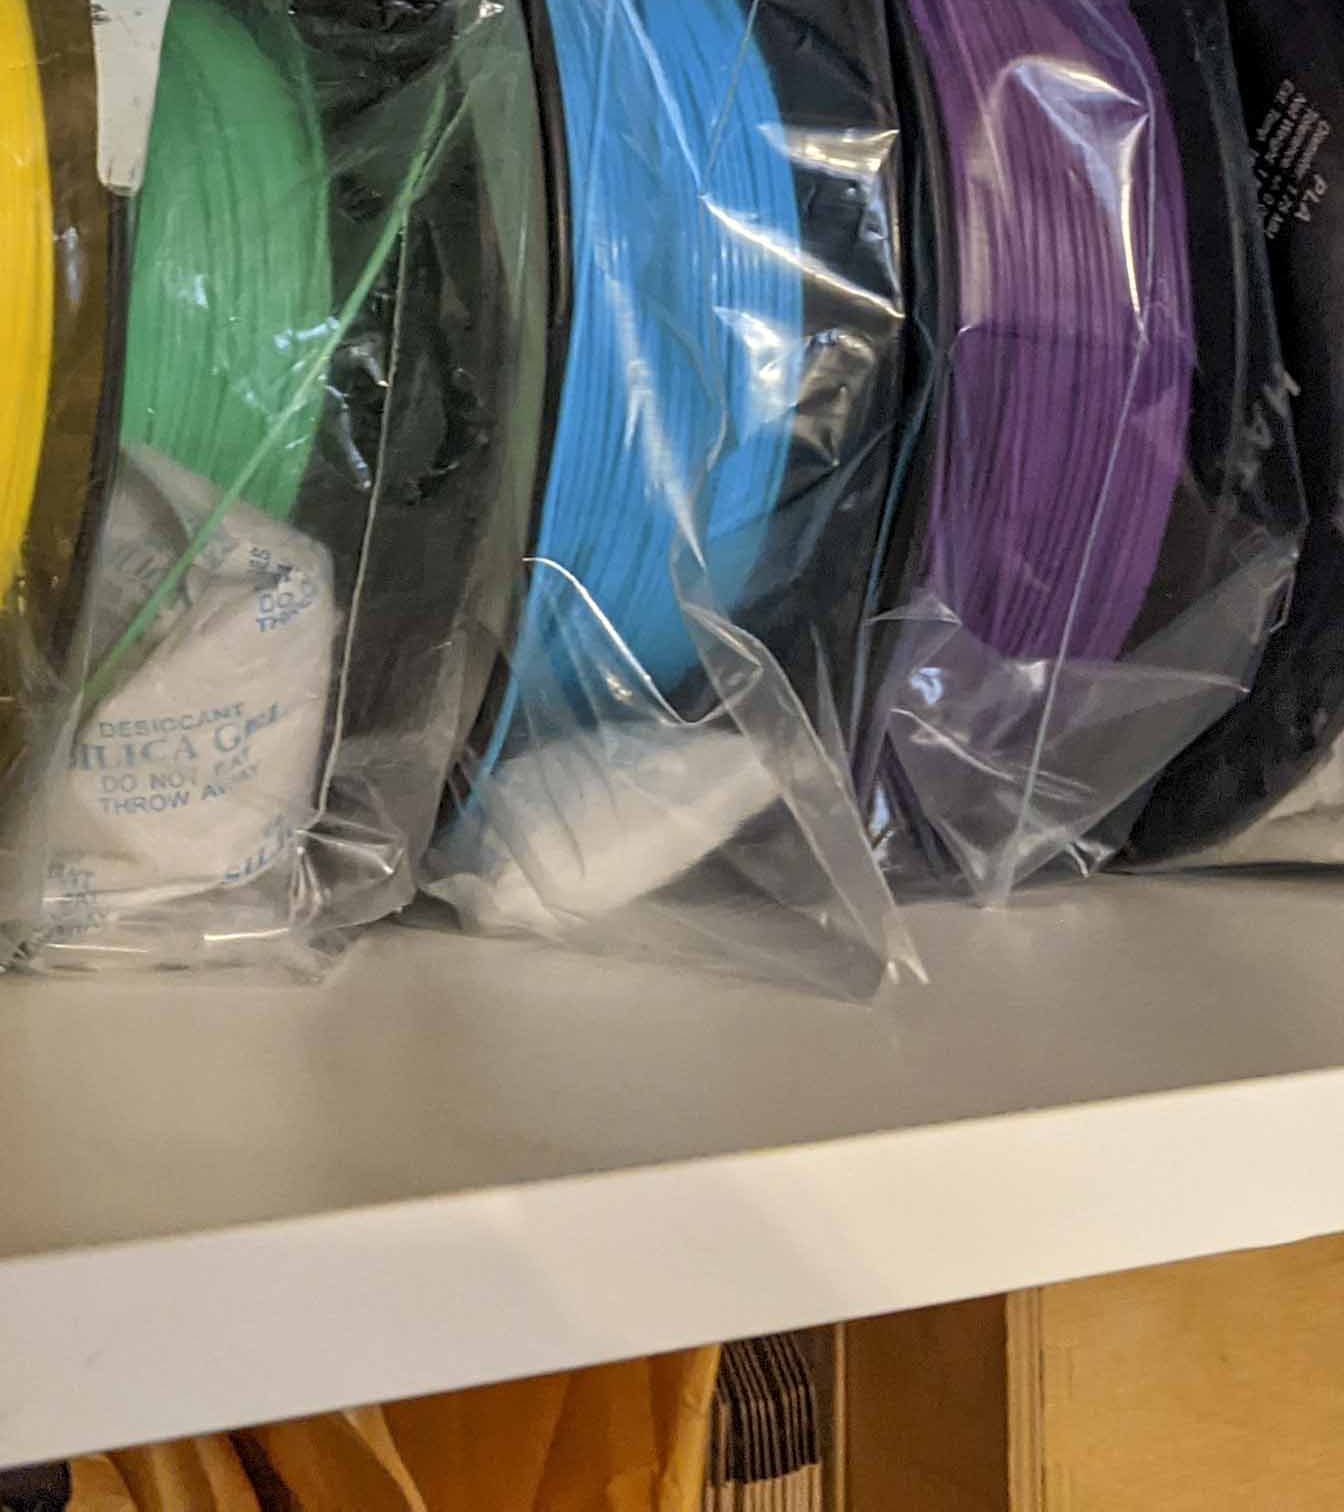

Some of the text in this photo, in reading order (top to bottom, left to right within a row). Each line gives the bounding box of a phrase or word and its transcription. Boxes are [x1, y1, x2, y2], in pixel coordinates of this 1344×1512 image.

[1294, 174, 1328, 222] PLA
[99, 702, 244, 738] DESICCANT
[101, 773, 138, 794] DO
[100, 791, 191, 817] THROW
